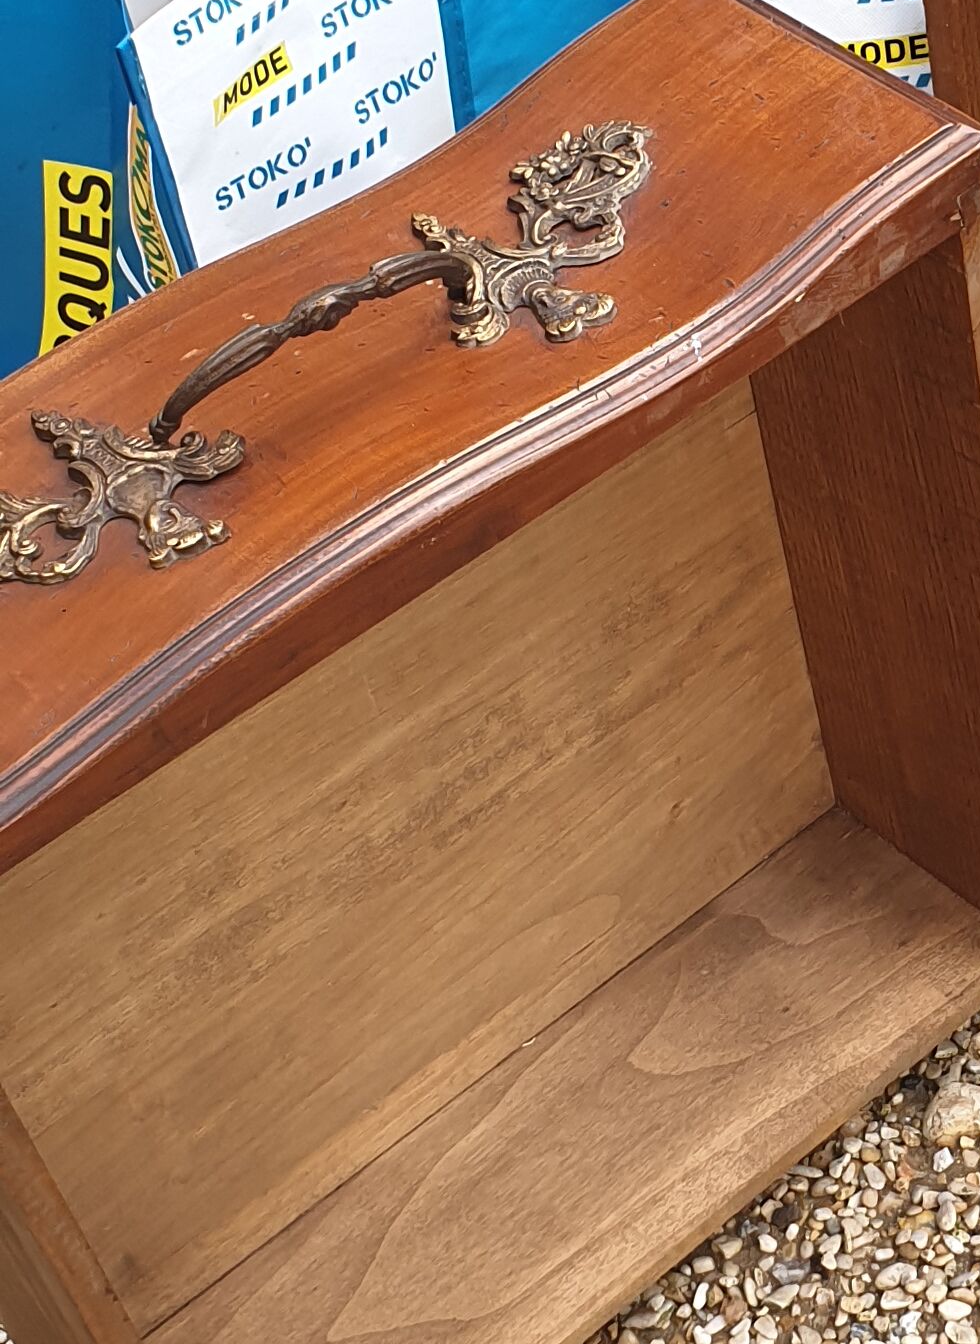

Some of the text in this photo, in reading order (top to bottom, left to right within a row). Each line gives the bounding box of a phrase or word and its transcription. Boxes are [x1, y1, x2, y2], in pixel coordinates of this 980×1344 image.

[222, 49, 289, 114] MODE
[848, 34, 929, 65] ODE
[354, 52, 438, 124] STOKO'
[215, 137, 312, 211] STOKO'
[54, 171, 112, 348] QUES
